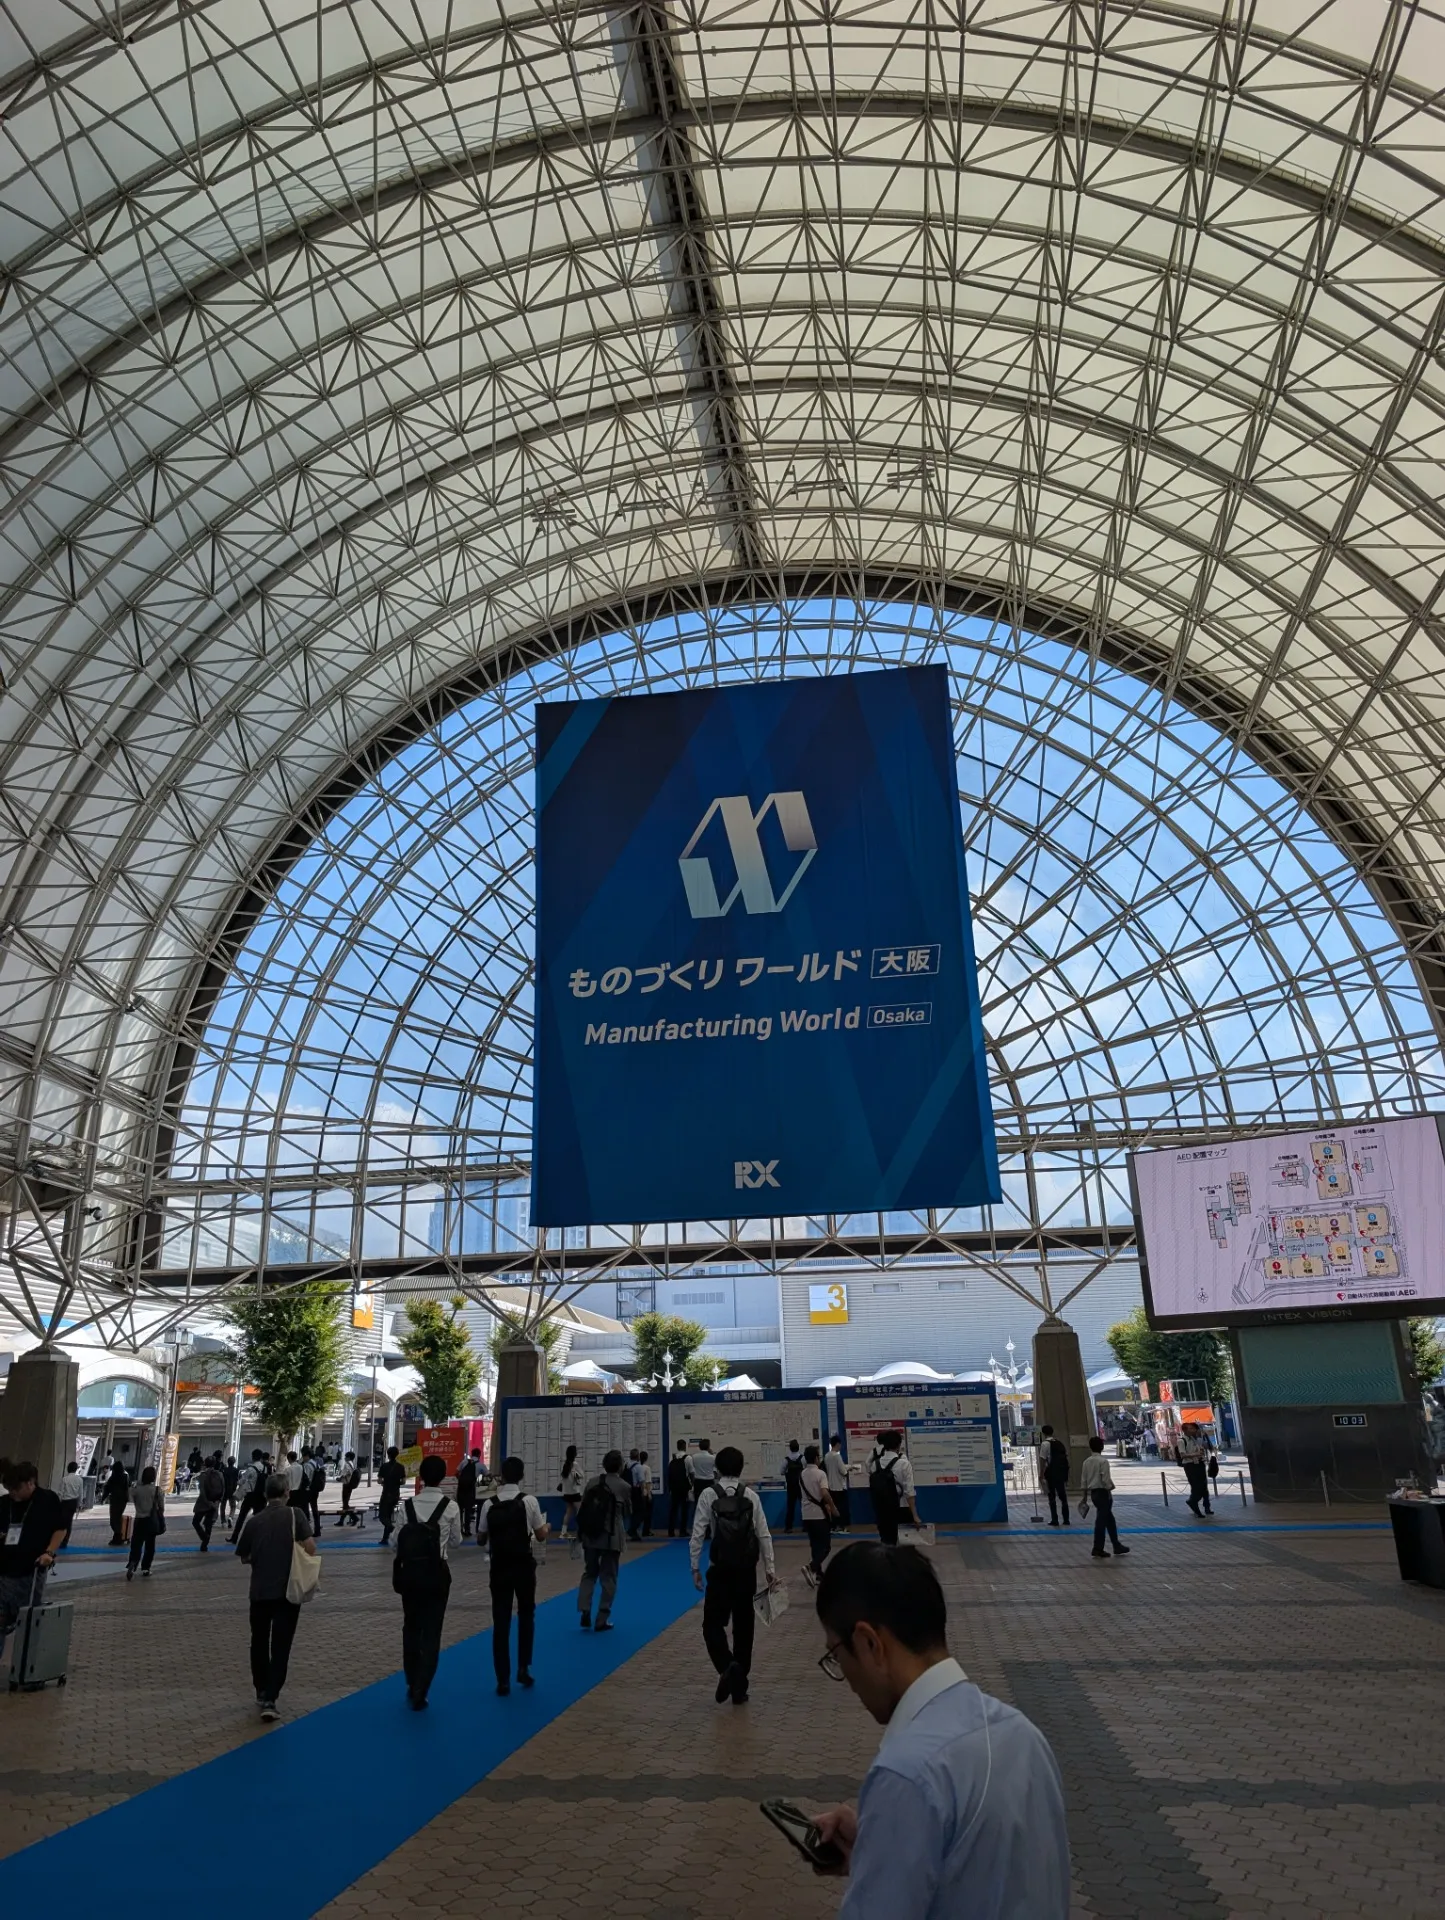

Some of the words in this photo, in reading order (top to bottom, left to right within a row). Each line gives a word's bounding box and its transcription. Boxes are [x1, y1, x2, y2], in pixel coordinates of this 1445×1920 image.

[567, 959, 724, 998] ものづくり
[735, 949, 861, 988] ワールド
[879, 949, 931, 974] 大阪
[584, 1013, 772, 1045] Manufacturing
[779, 1006, 861, 1033] World
[873, 1007, 926, 1025] Osaka
[1176, 1153, 1192, 1161] AED
[734, 1159, 781, 1189] RX
[827, 1284, 847, 1311] 3
[1262, 1312, 1301, 1321] INTEX
[1307, 1308, 1353, 1319] VISION
[564, 1395, 605, 1405] 出展社一覧
[1124, 1389, 1134, 1401] 3
